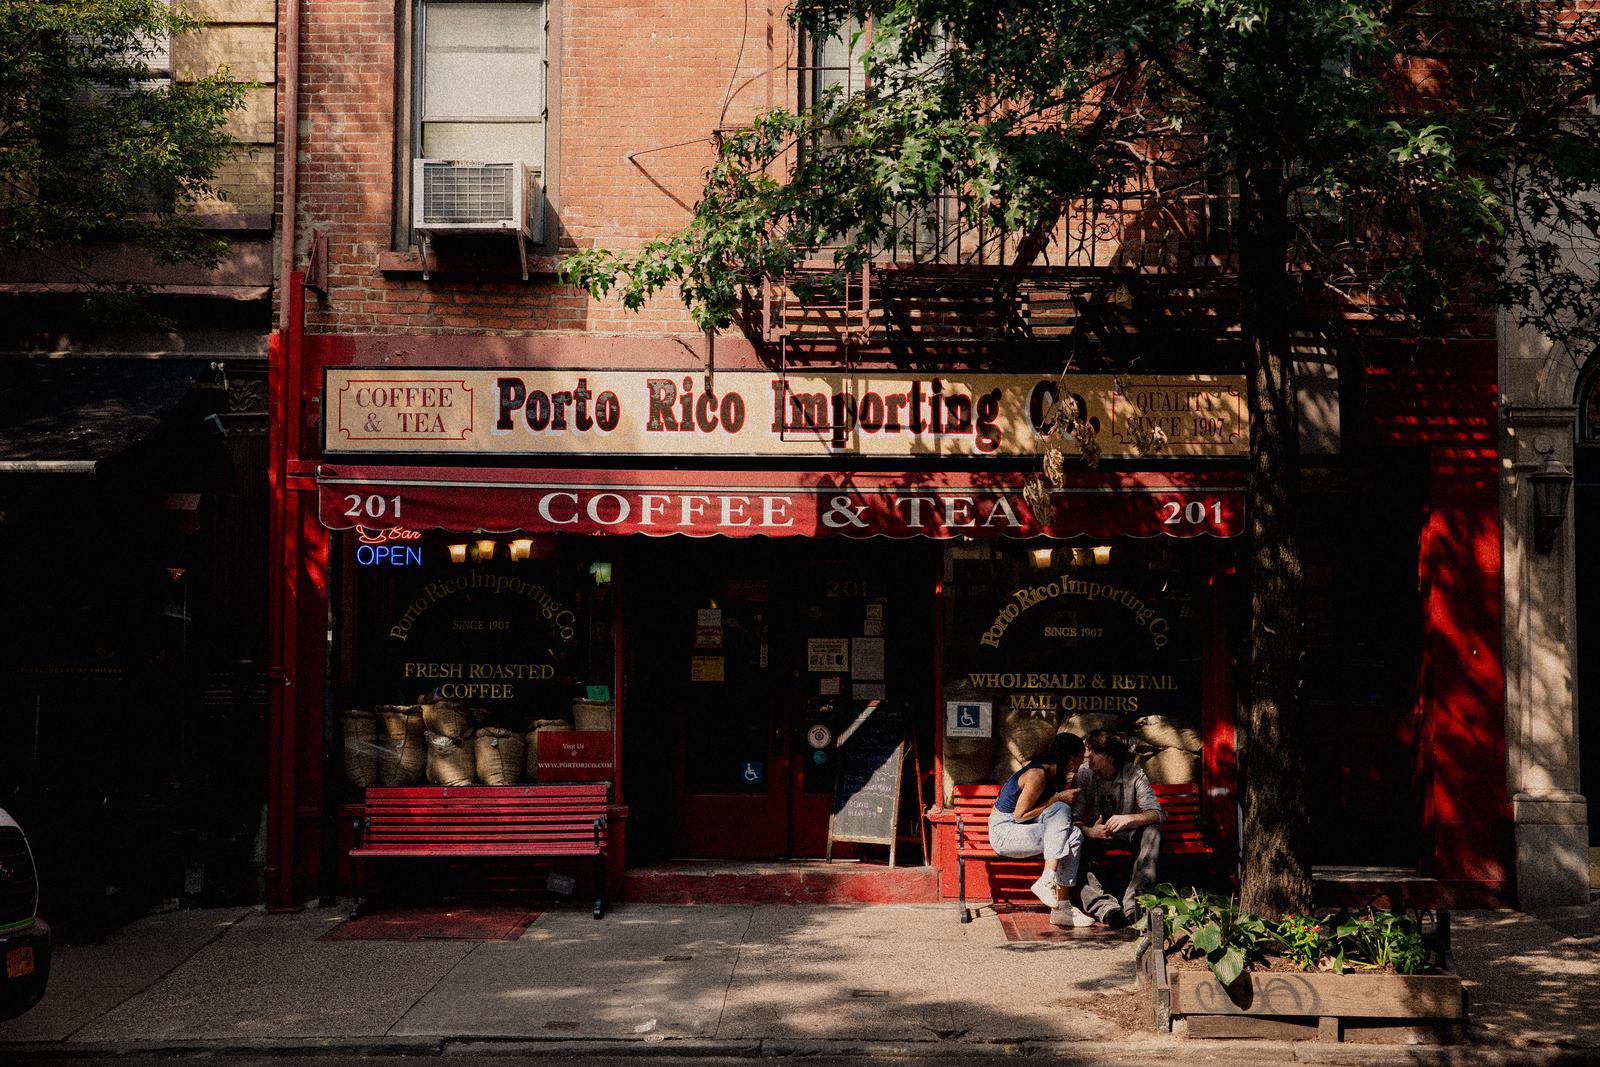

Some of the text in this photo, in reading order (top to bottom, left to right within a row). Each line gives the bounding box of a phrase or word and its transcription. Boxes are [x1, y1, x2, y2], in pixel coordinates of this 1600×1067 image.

[356, 387, 453, 408] COFFEE
[1136, 392, 1217, 415] QUALITY
[363, 412, 447, 433] & TEA
[496, 377, 621, 433] Porto
[646, 375, 746, 434] Rico
[771, 376, 1002, 453] Importing
[1194, 417, 1225, 437] 1907
[343, 493, 402, 518] 201
[538, 491, 1024, 529] COFFEE & TEA
[1162, 501, 1223, 526] 201
[388, 526, 422, 540] Bar
[356, 544, 422, 566] OPEN
[389, 597, 428, 641] Porto
[423, 573, 468, 602] Rico
[470, 569, 560, 619] Importing
[980, 574, 1169, 651] Porto Rico Importing Co.
[452, 619, 512, 631] SINCE 1907
[1043, 626, 1104, 638] SINCE 1907
[404, 662, 556, 680] FRESH ROASTED
[968, 672, 1180, 691] WHOLESALE & RETAIL
[441, 683, 515, 699] COFFEE
[1008, 694, 1140, 713] MAIL ORDERS
